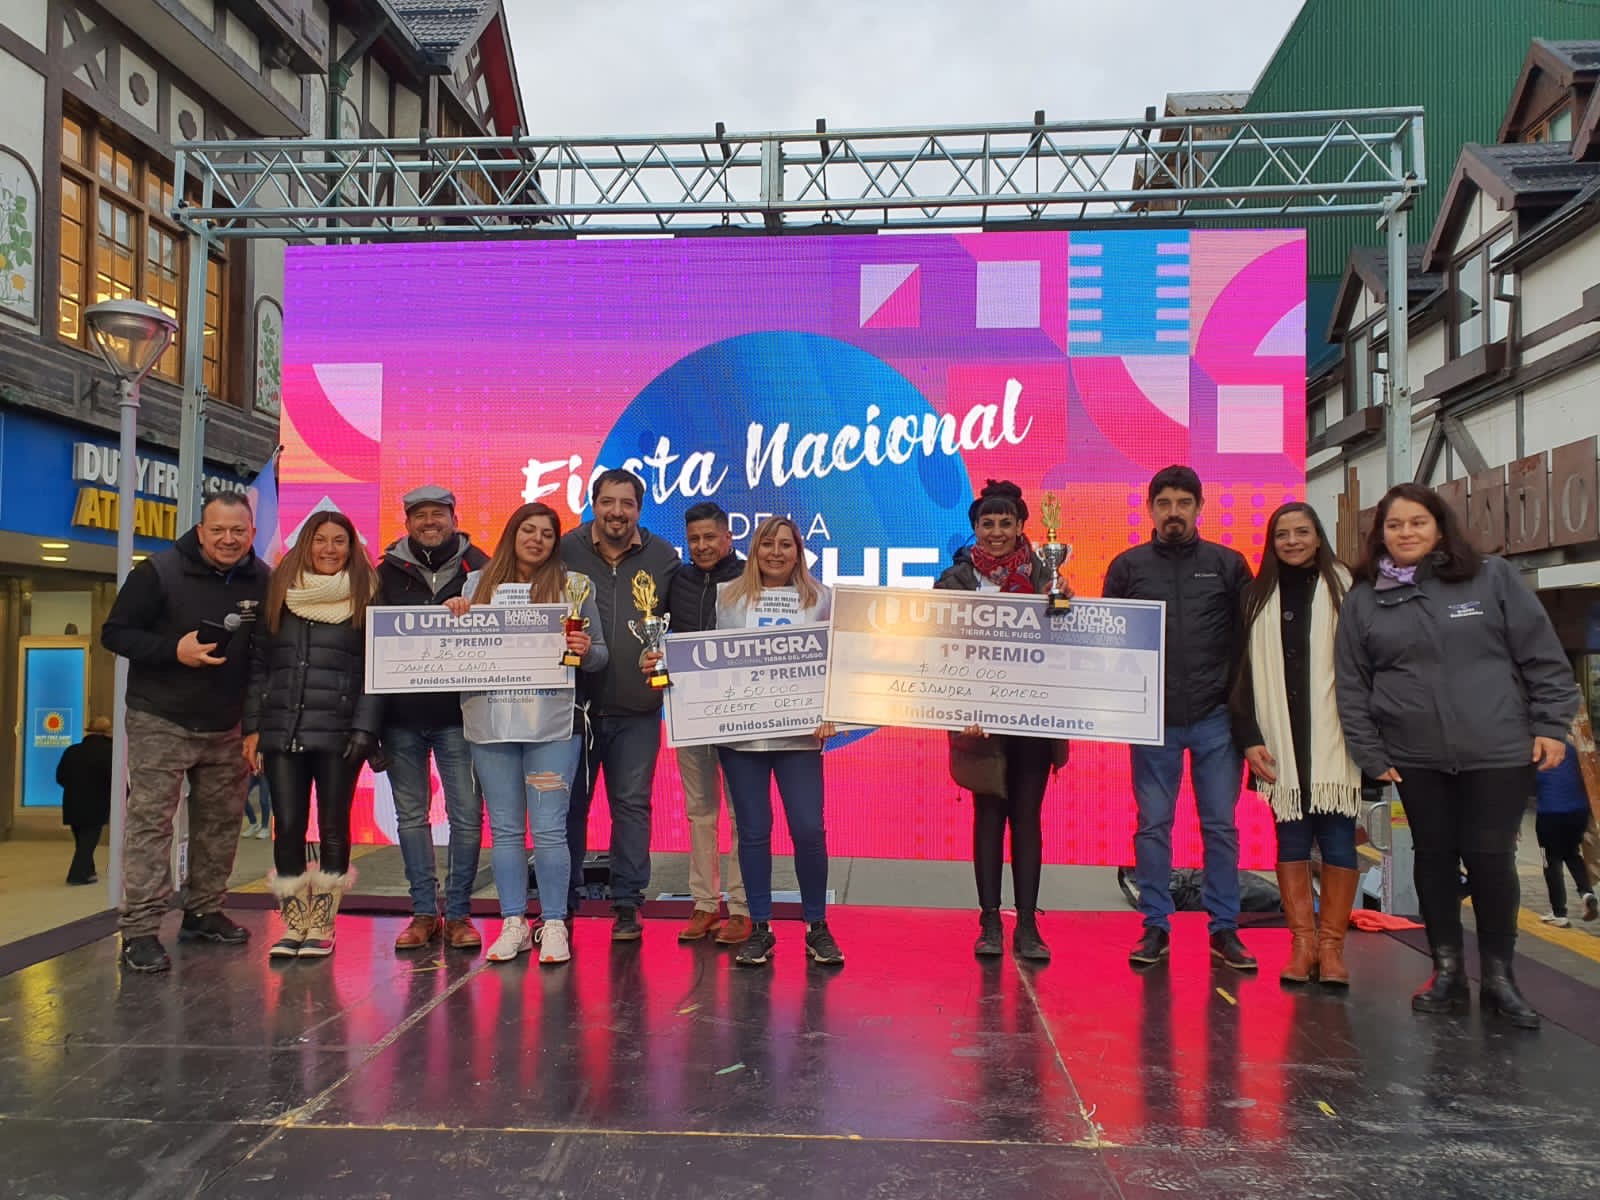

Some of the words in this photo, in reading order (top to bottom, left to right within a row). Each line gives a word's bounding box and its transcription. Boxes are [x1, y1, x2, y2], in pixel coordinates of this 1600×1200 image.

[521, 435, 729, 515] Fista
[745, 377, 1033, 491] Nacional
[73, 442, 149, 491] DUY
[420, 612, 500, 629] UTHGRA
[909, 598, 1041, 630] UTHGRA
[960, 627, 991, 637] TIERRA
[993, 629, 1010, 638] DEL
[1012, 631, 1041, 640] FUEGO
[455, 637, 503, 648] PREMIO
[723, 634, 823, 659] UTHGRA
[965, 644, 1046, 664] PREMIO
[410, 674, 532, 686] #UnidosSalimosAdelante
[770, 664, 827, 681] PREMIO
[989, 685, 1049, 699] ROMERO
